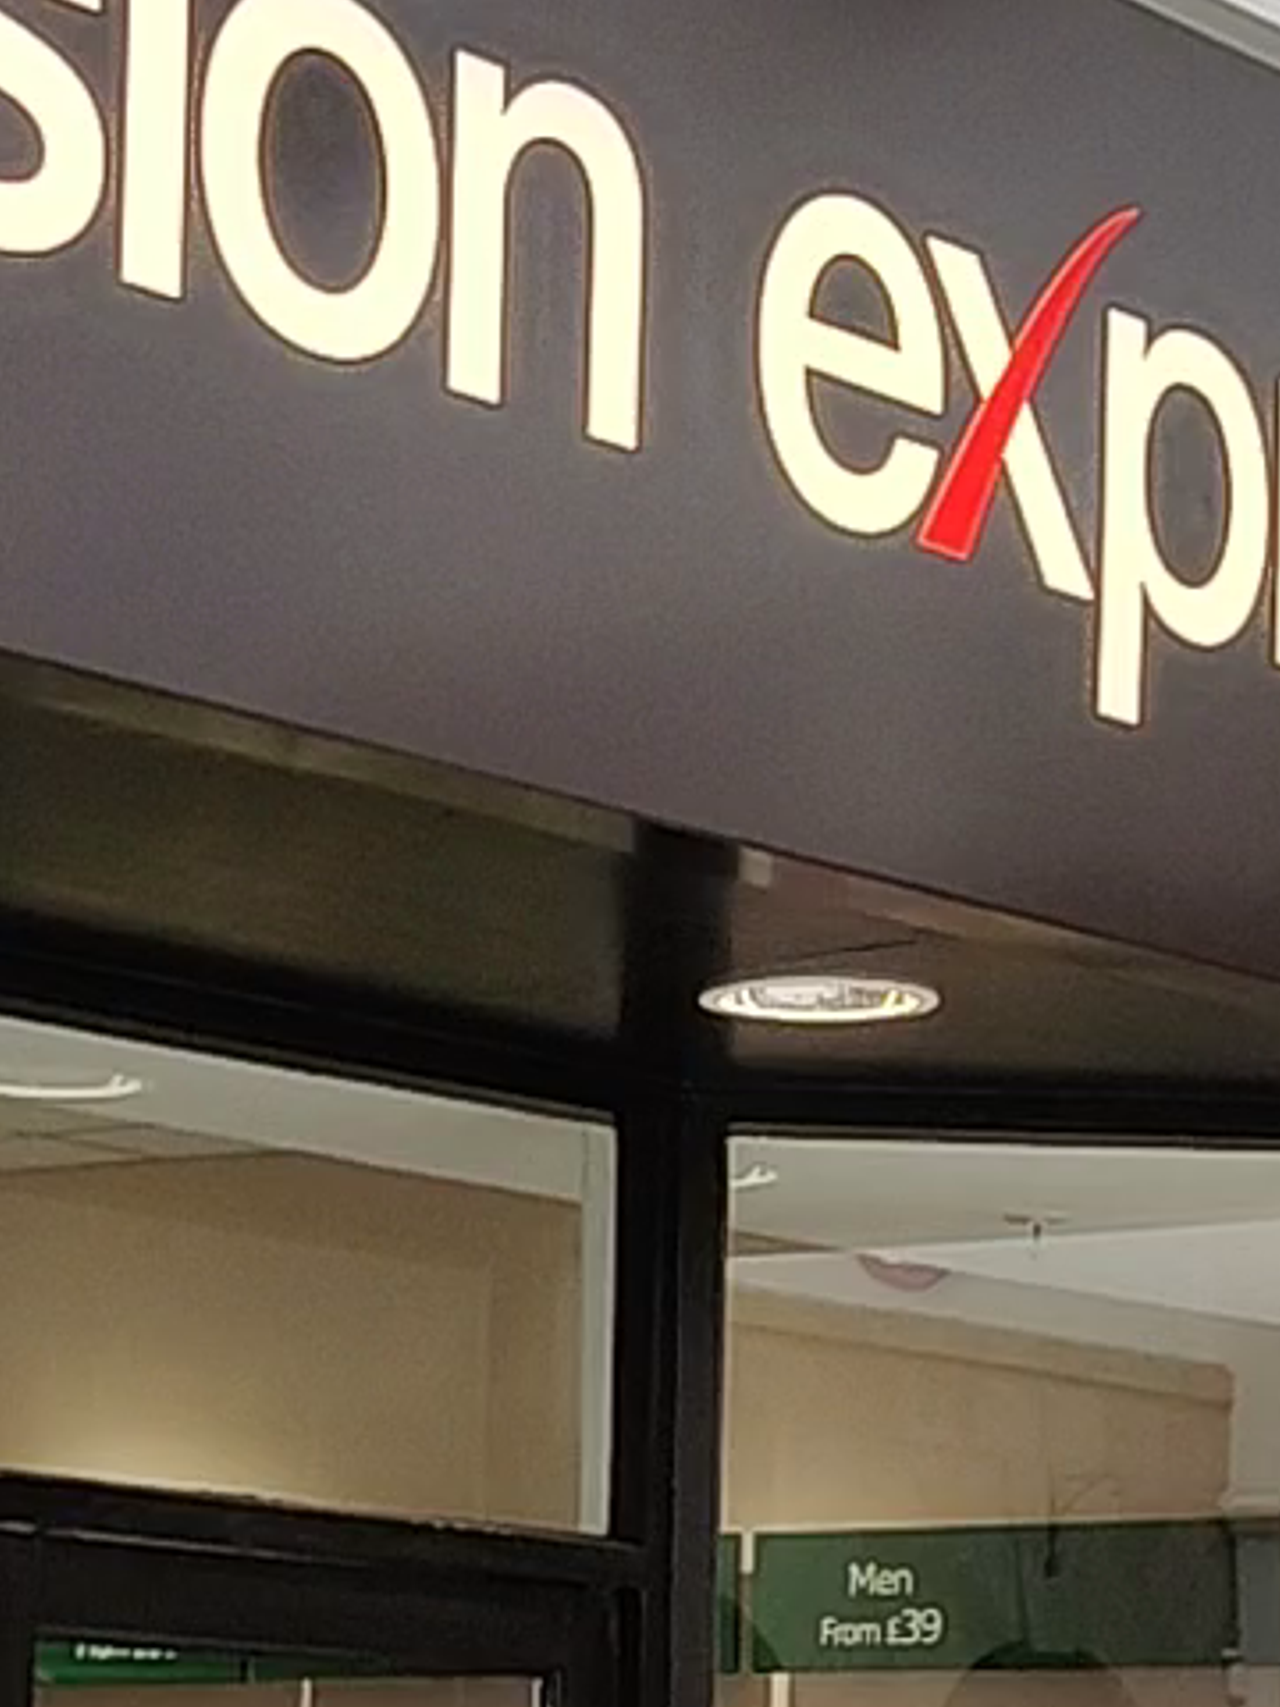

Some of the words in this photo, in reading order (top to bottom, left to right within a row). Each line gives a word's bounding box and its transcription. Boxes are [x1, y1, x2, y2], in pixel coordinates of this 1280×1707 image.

[848, 1561, 914, 1596] Men
[819, 1616, 882, 1647] From
[886, 1608, 943, 1645] £39
